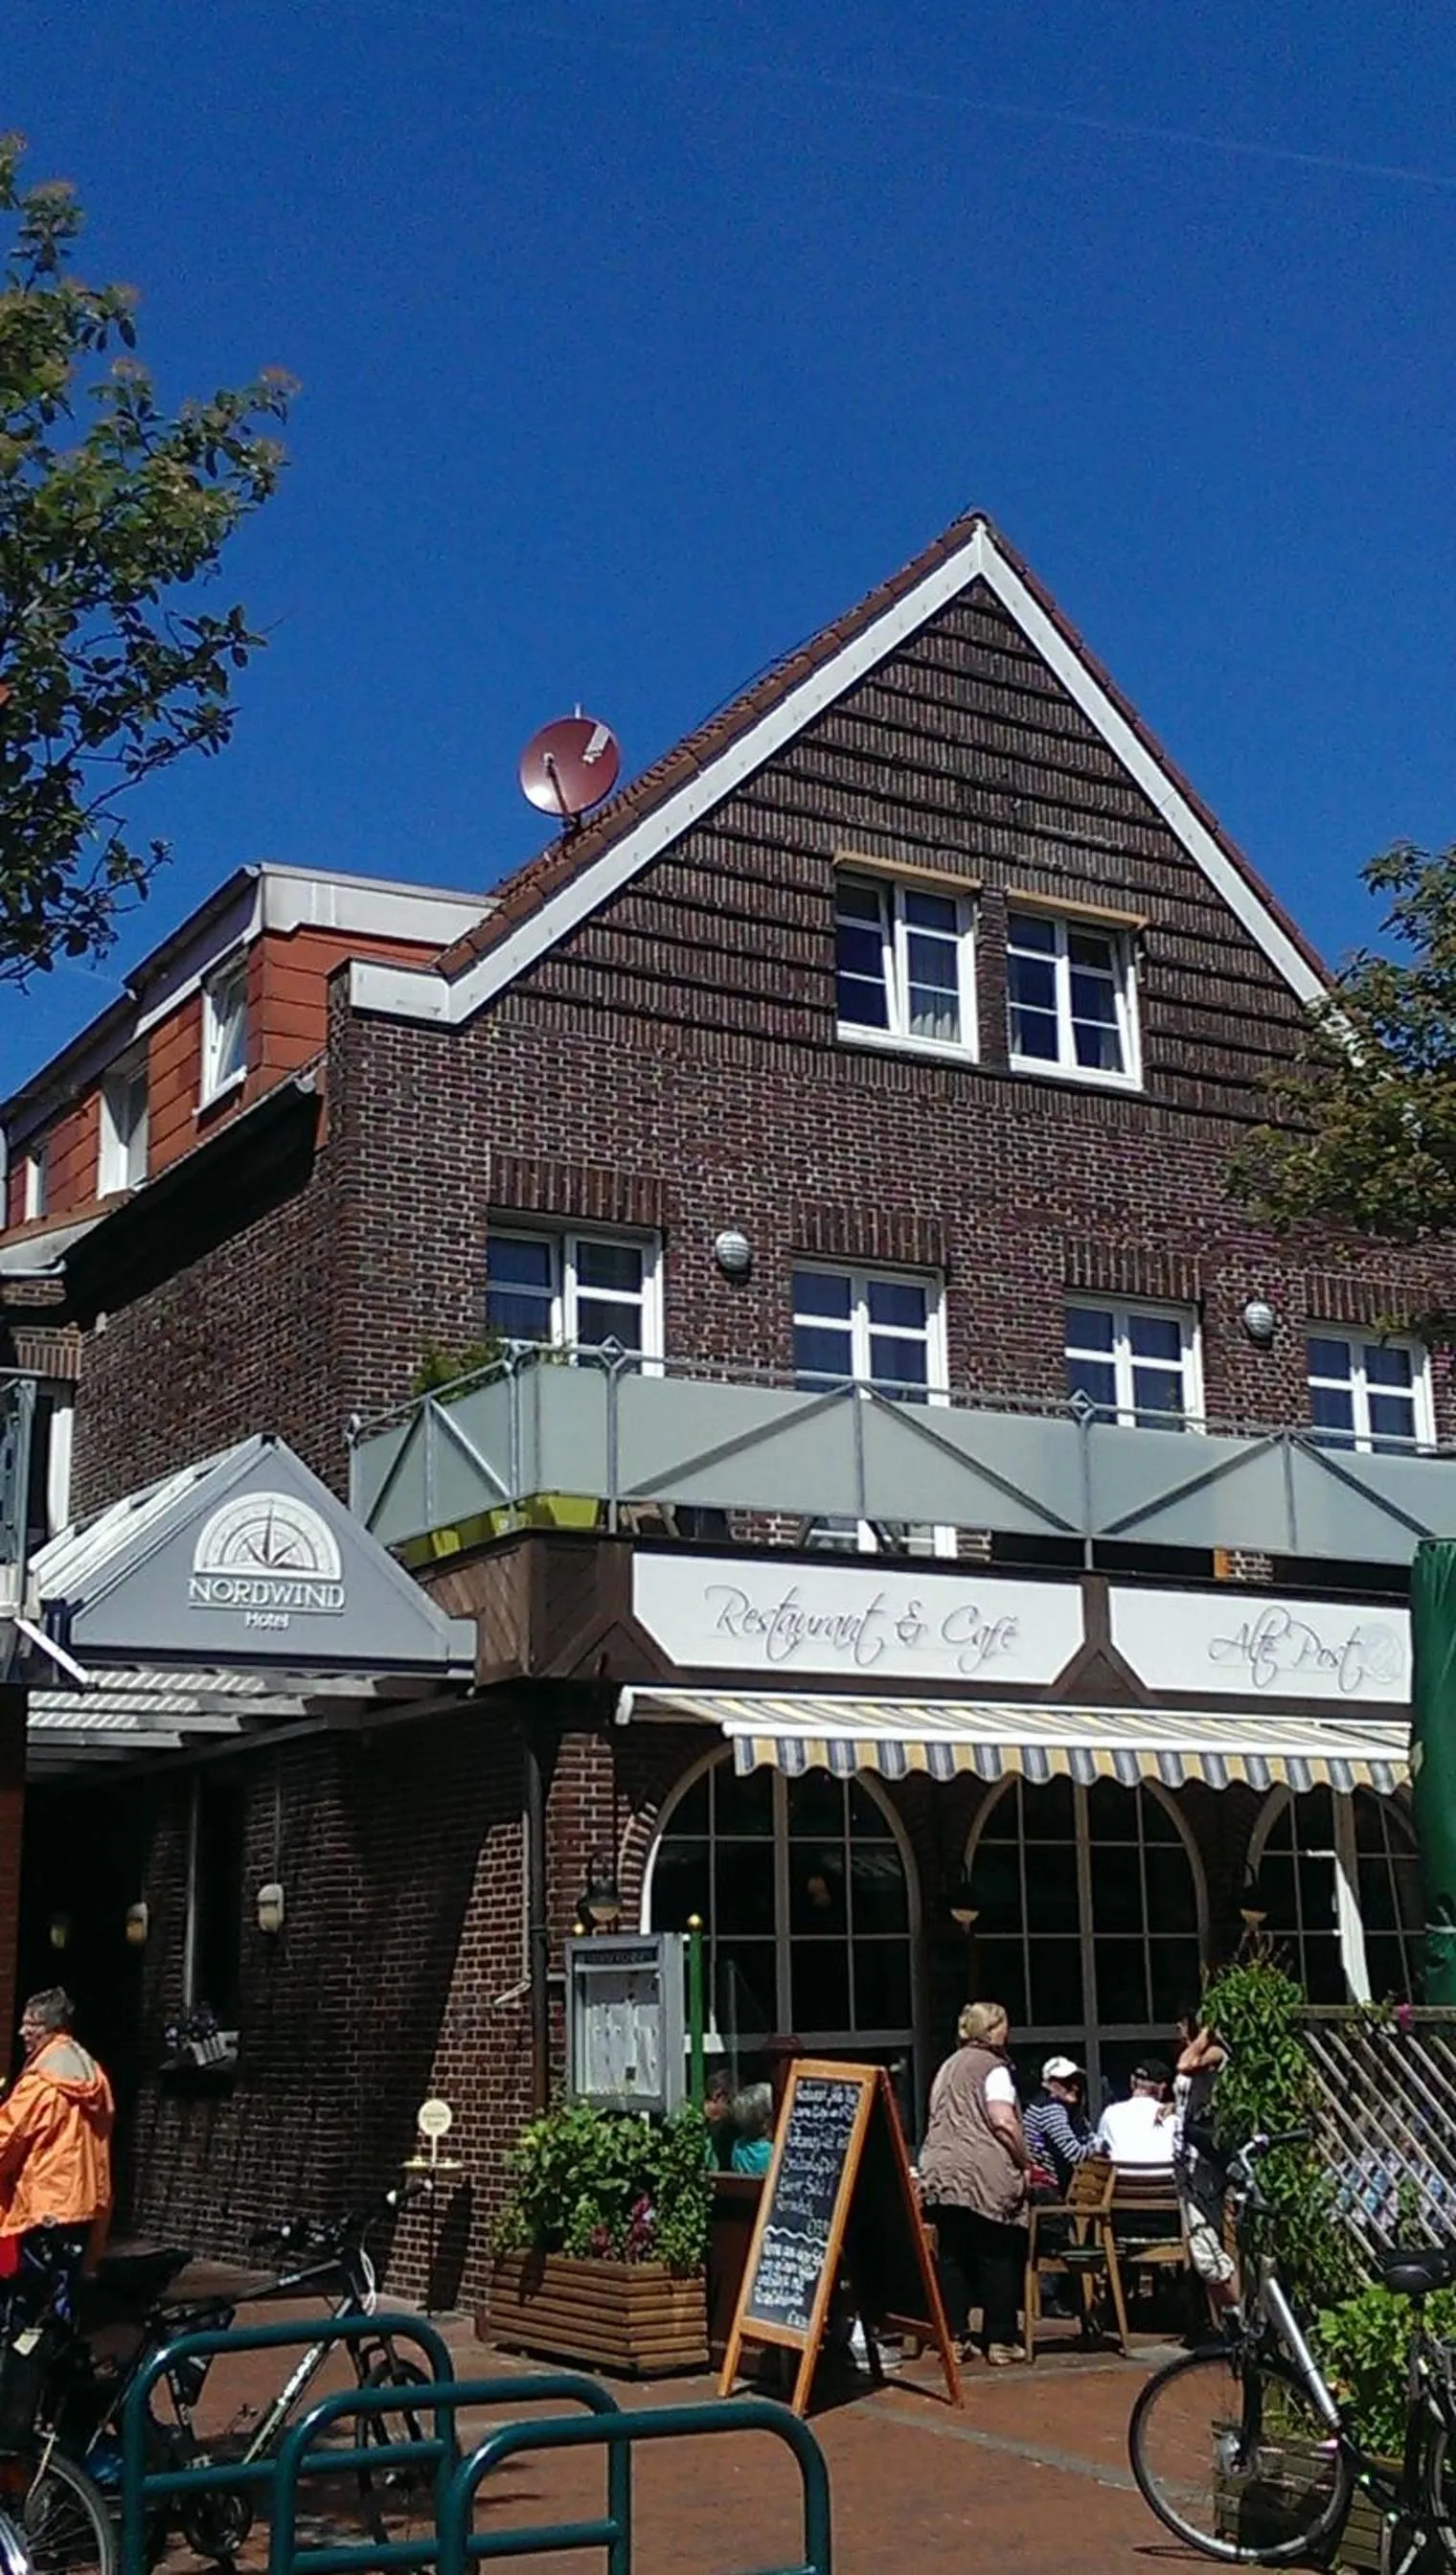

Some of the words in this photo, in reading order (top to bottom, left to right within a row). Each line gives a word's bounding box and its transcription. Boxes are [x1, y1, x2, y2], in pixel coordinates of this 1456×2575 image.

[189, 1578, 345, 1608] NORDWIND
[245, 1611, 289, 1629] Hotel
[705, 1584, 885, 1667] Restaurant
[894, 1599, 927, 1646] &
[941, 1604, 1019, 1675] Café
[1208, 1605, 1289, 1688] Alte
[1287, 1620, 1364, 1693] Post
